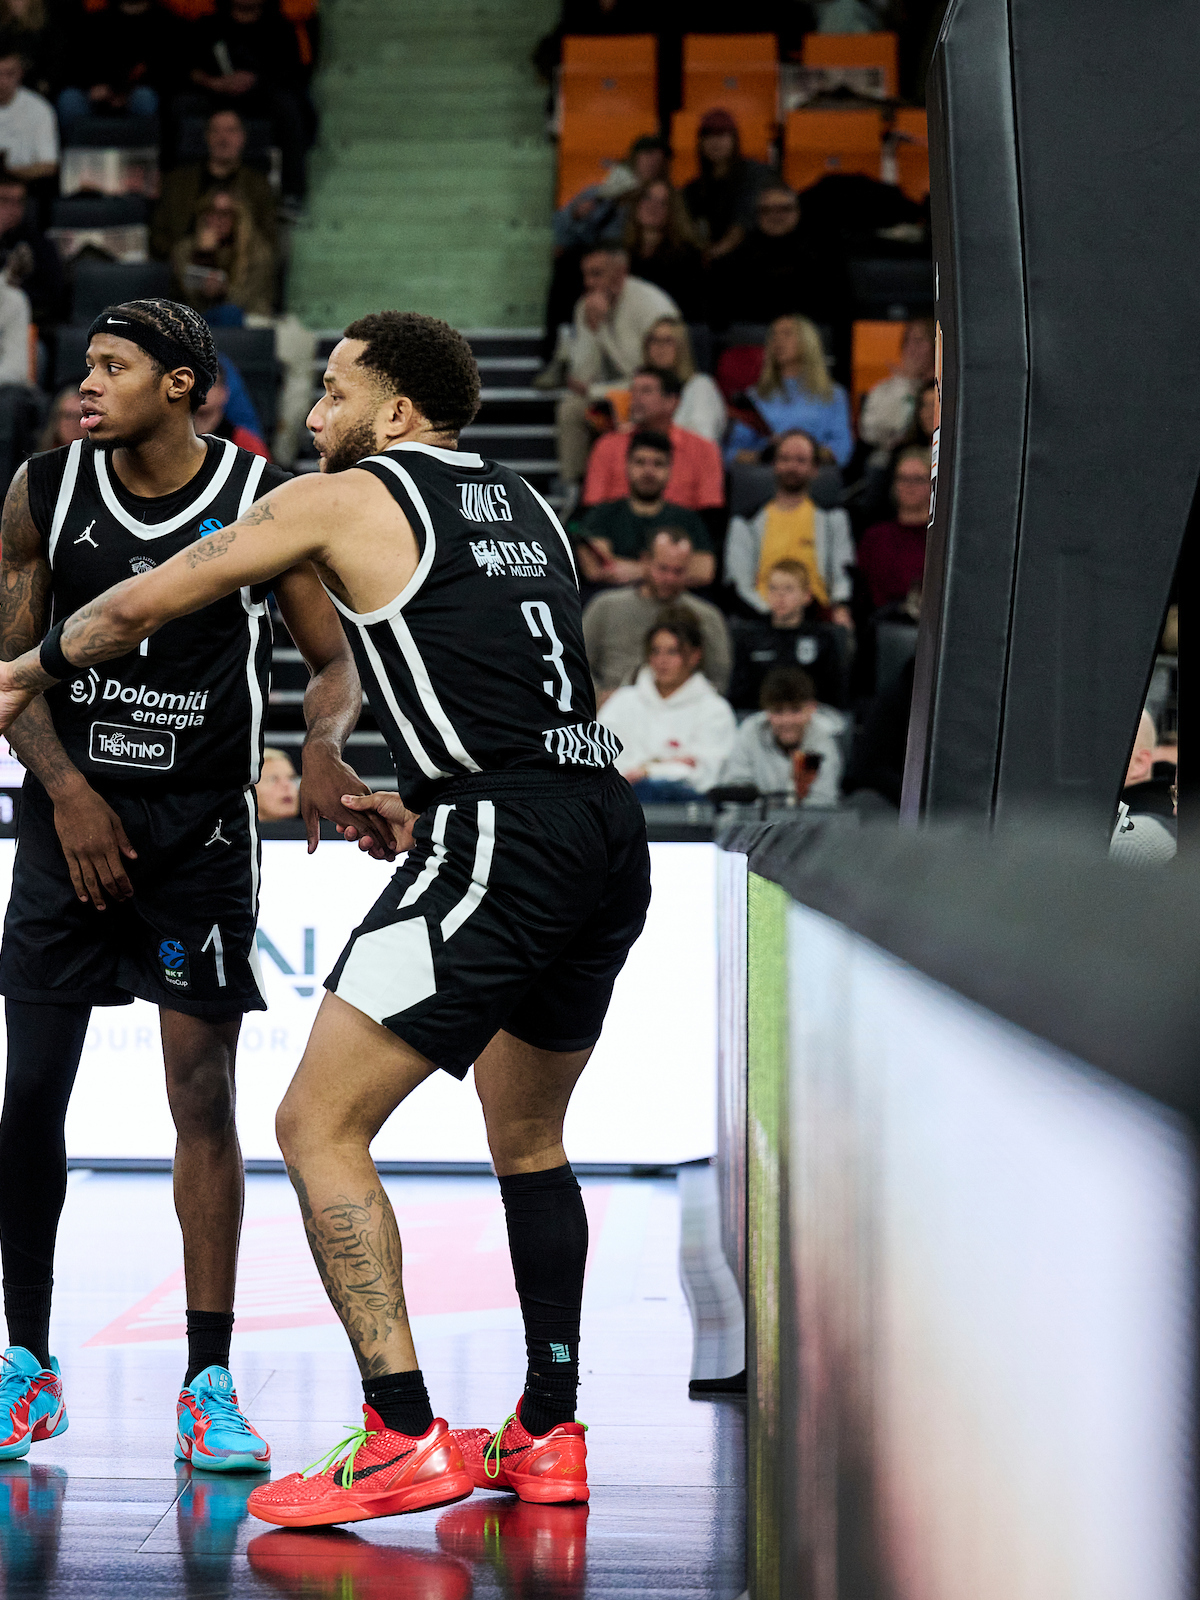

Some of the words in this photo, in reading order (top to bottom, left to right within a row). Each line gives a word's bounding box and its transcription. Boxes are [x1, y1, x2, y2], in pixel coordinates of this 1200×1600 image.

[455, 483, 513, 522] JONES
[497, 541, 548, 566] ITAS
[509, 565, 547, 577] MUTUA
[520, 600, 574, 712] 3
[102, 679, 210, 711] Dolomiti
[131, 709, 205, 730] energia
[98, 733, 165, 760] TRENTINO
[201, 923, 227, 987] 1
